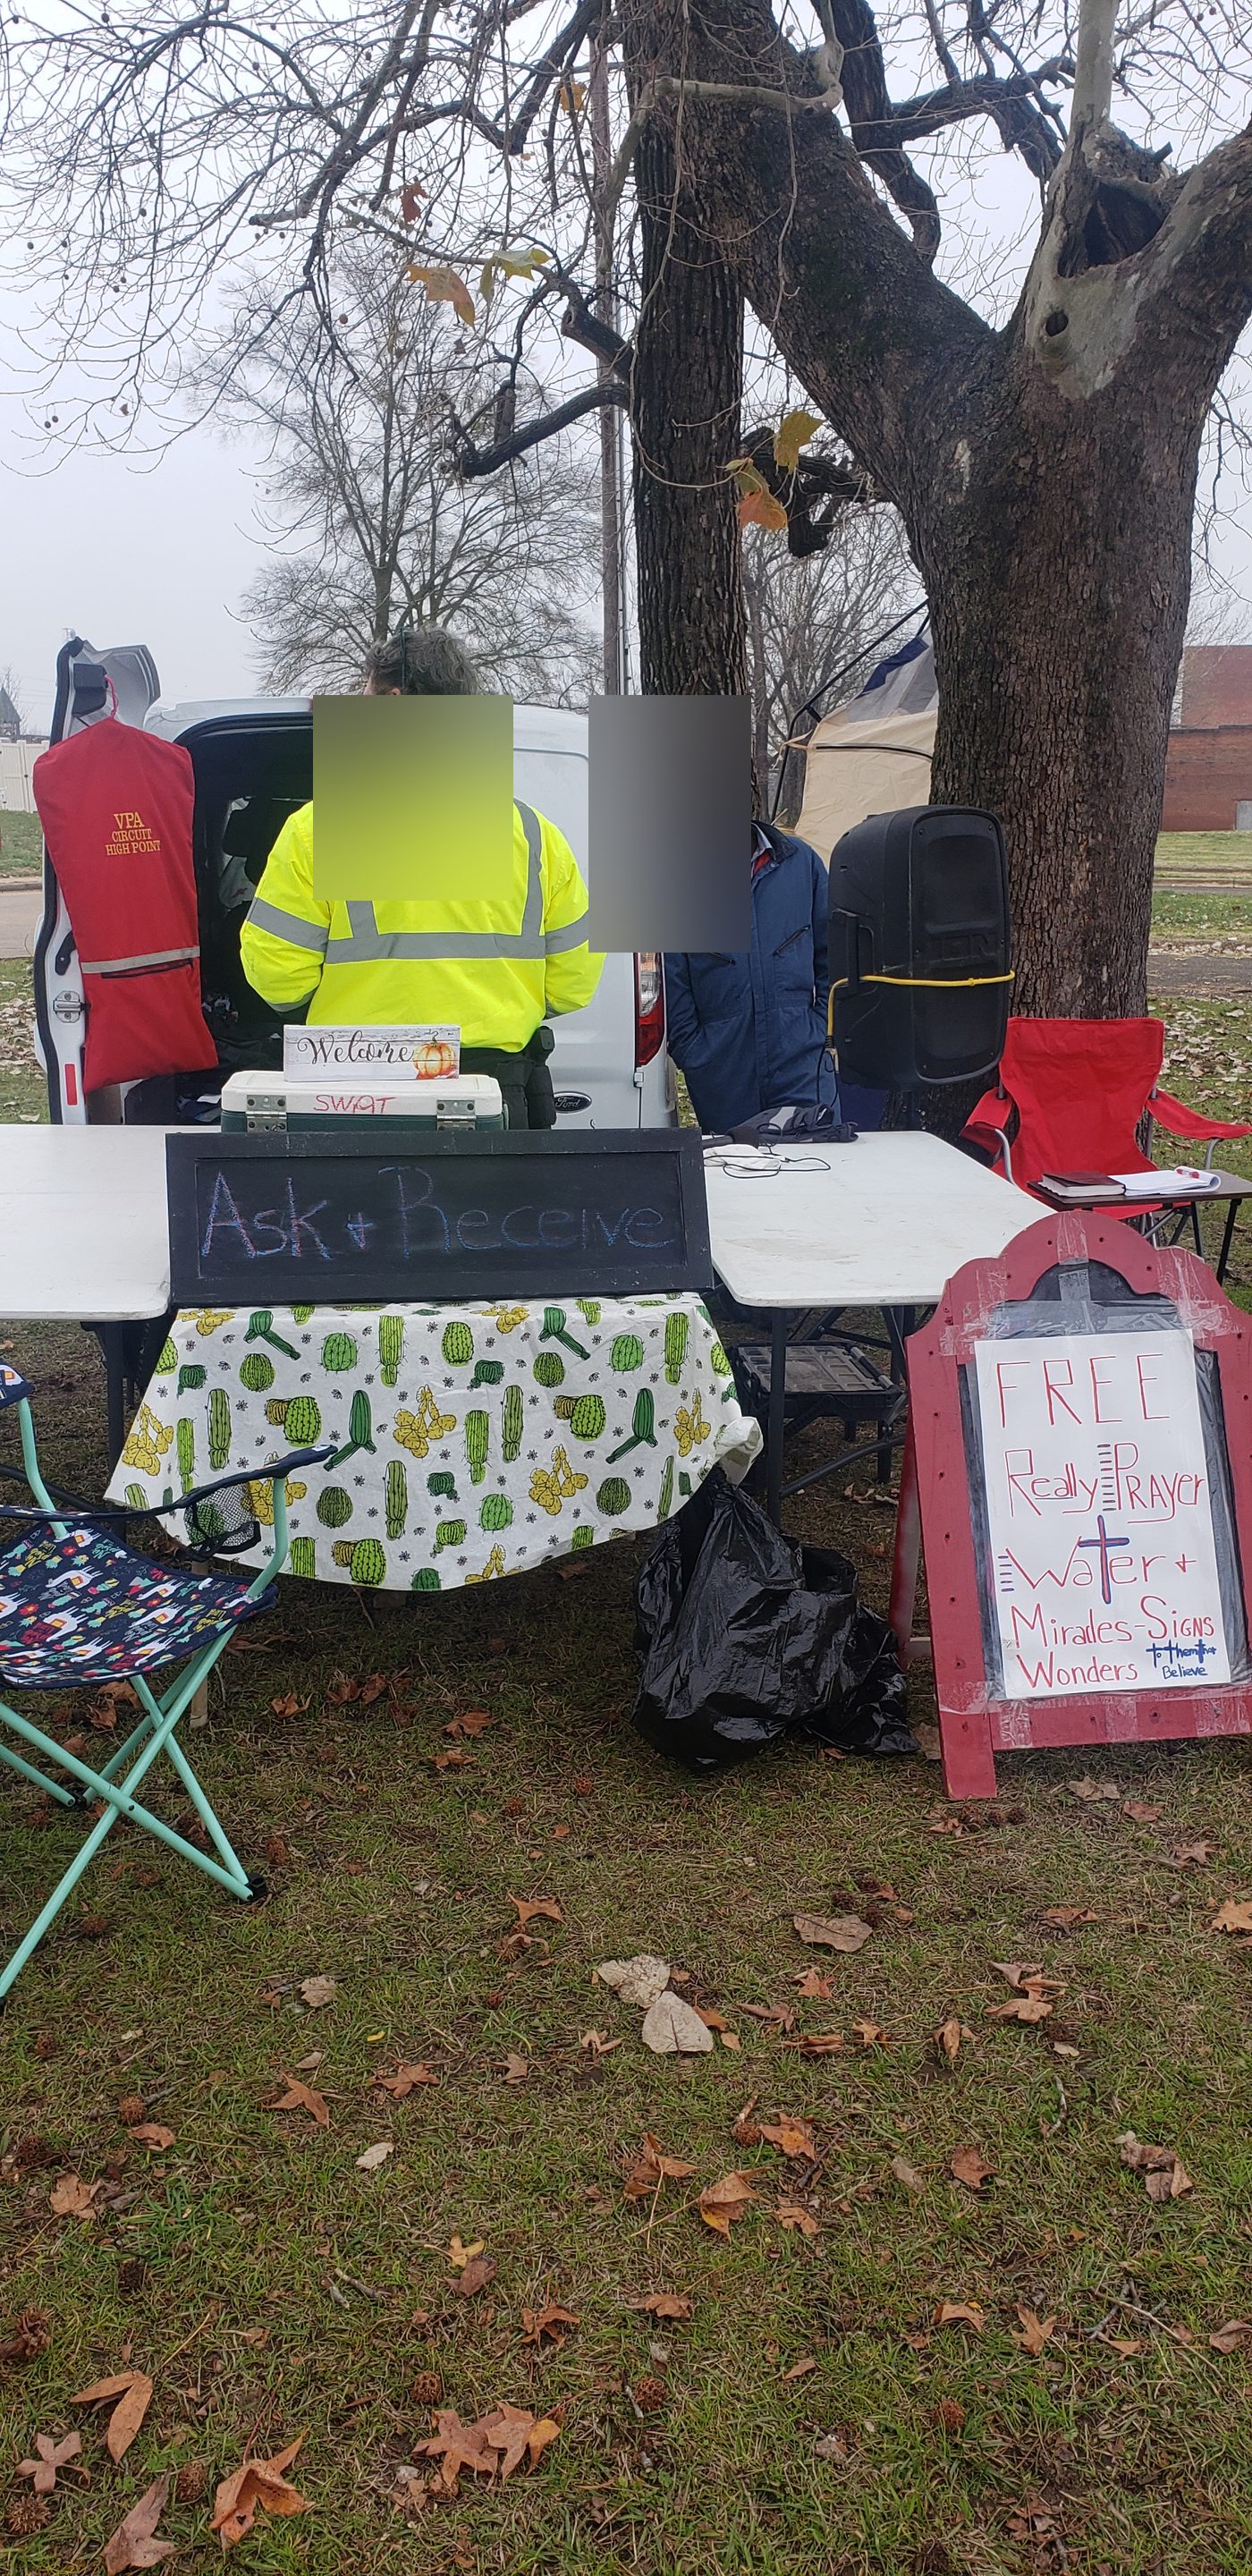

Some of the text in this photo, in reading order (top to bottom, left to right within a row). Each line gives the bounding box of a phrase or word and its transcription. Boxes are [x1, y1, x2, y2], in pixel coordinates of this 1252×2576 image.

[114, 811, 145, 829] VPA
[106, 840, 161, 856] HIGH POINT
[112, 828, 152, 842] CIRCUIT
[297, 1030, 414, 1063] Welcome
[313, 1094, 396, 1114] SWAT
[555, 1097, 580, 1108] Ford
[200, 1170, 334, 1260] Ask
[377, 1165, 677, 1260] Receive
[996, 1353, 1171, 1428] FREE
[1005, 1448, 1099, 1517] Really
[1005, 1514, 1166, 1605] Water
[1016, 1651, 1138, 1690] Wonders
[1162, 1663, 1208, 1679] Believe
